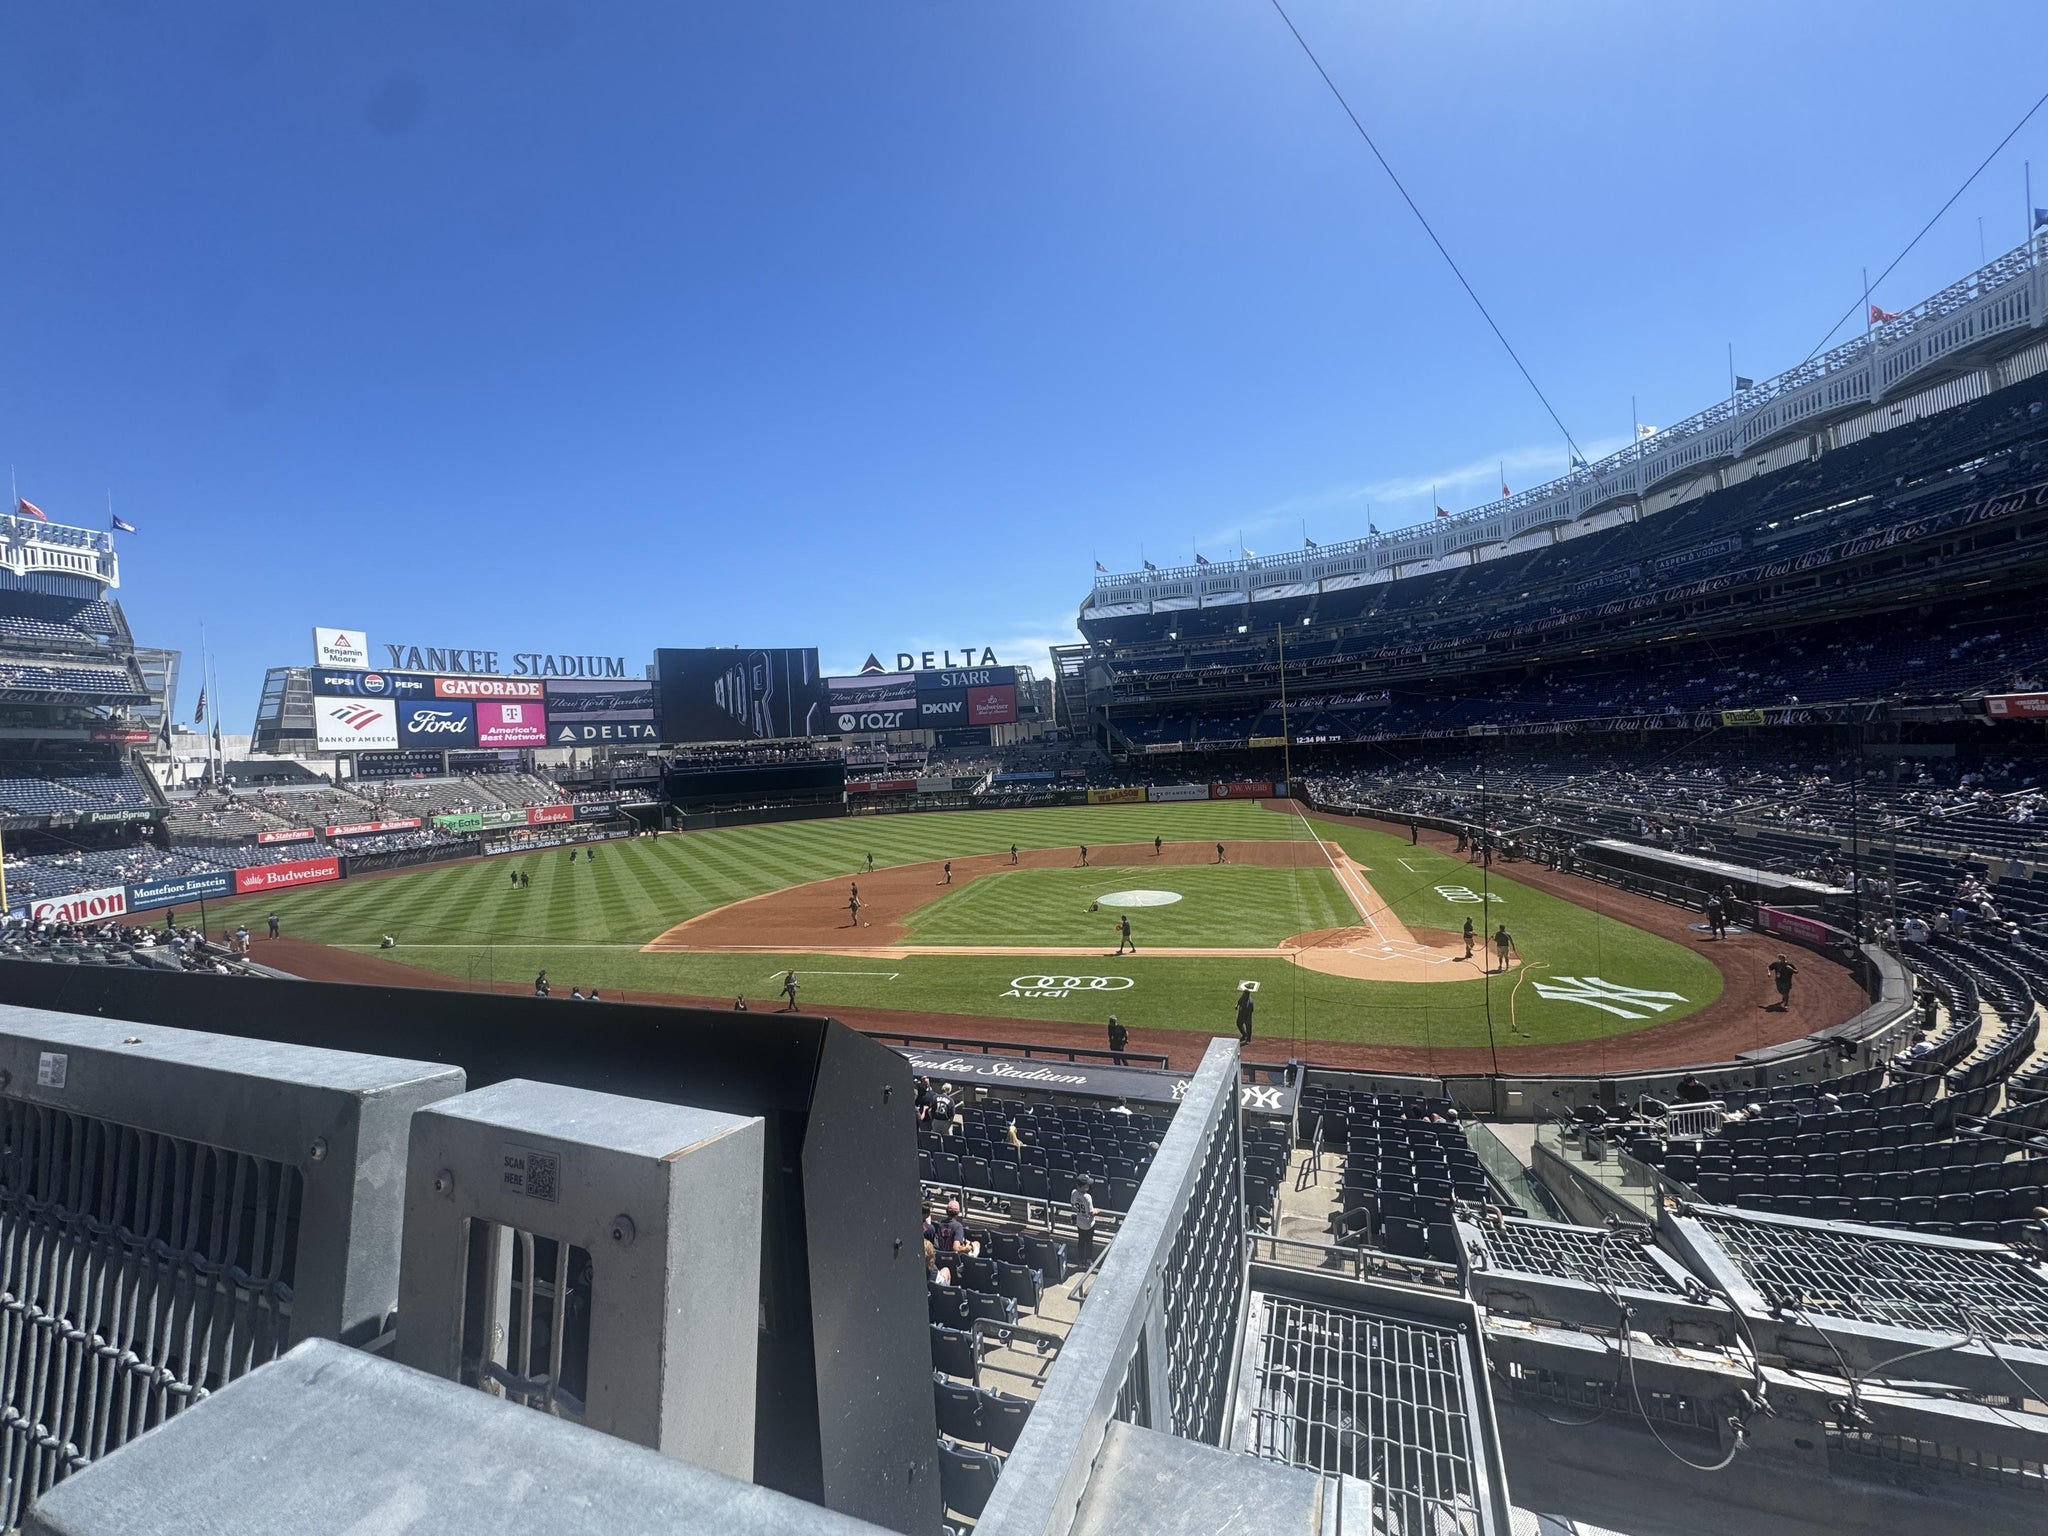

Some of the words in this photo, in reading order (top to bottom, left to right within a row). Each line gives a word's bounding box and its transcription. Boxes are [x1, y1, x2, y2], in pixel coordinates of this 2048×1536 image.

[323, 646, 363, 657] Benjamin
[329, 654, 357, 663] Moore
[384, 644, 500, 674] YANKEE
[513, 652, 626, 677] STADIUM
[896, 646, 998, 671] DELTA
[324, 677, 355, 686] PEPSI
[395, 681, 423, 690] PEPSI
[941, 670, 991, 688] STARR
[442, 680, 540, 696] GATORADE
[922, 701, 963, 715] DKNY
[407, 710, 468, 733] Ford
[859, 712, 904, 730] razr
[488, 726, 537, 734] America's
[583, 725, 657, 740] DELTA
[480, 734, 503, 742] Best
[505, 733, 546, 741] Network
[1296, 736, 1315, 744] 12:34
[589, 804, 610, 812] coupa
[92, 812, 122, 823] Poland
[122, 810, 150, 821] Spring
[458, 818, 481, 828] Eats
[511, 842, 535, 852] StubHub
[536, 838, 561, 849] StubHub
[487, 846, 510, 856] StubHub
[266, 866, 336, 884] Budweiser
[134, 884, 185, 899] Montefiore
[186, 877, 226, 890] Einstein
[34, 893, 124, 923] Canon
[999, 988, 1070, 998] Audi
[976, 1062, 1088, 1084] Stadium
[504, 1156, 525, 1170] SCAN
[504, 1172, 524, 1186] HERE
